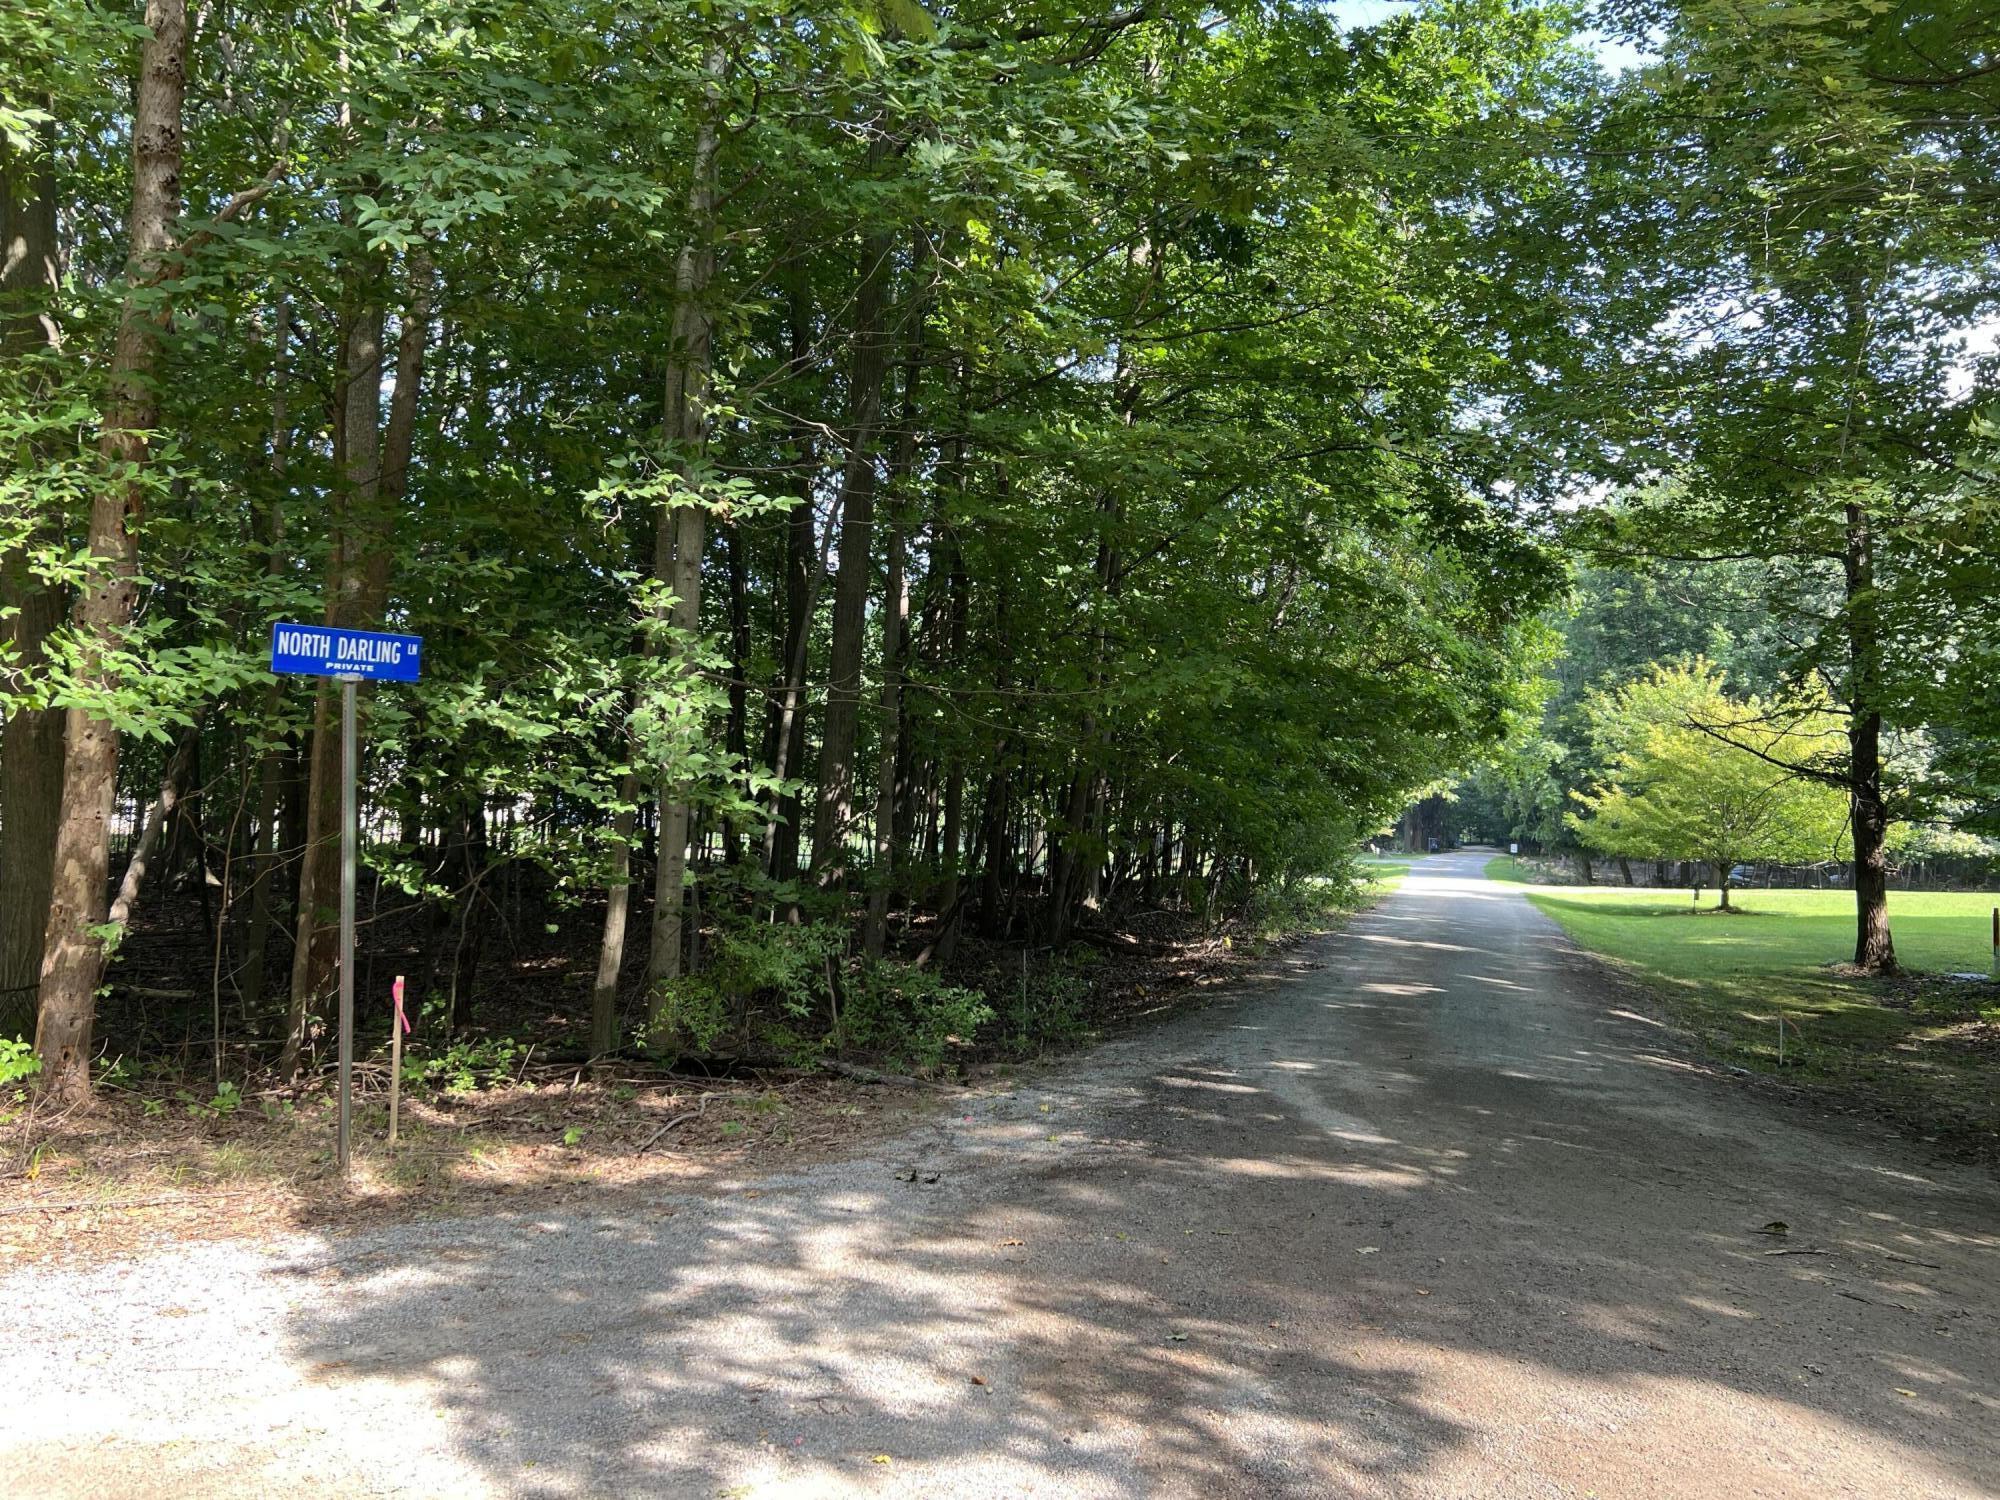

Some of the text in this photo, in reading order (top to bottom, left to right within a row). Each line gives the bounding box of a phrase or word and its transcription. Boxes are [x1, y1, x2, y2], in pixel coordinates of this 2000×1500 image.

[278, 631, 418, 664] NORTH DARLING LN
[326, 662, 374, 672] PRIVATE
